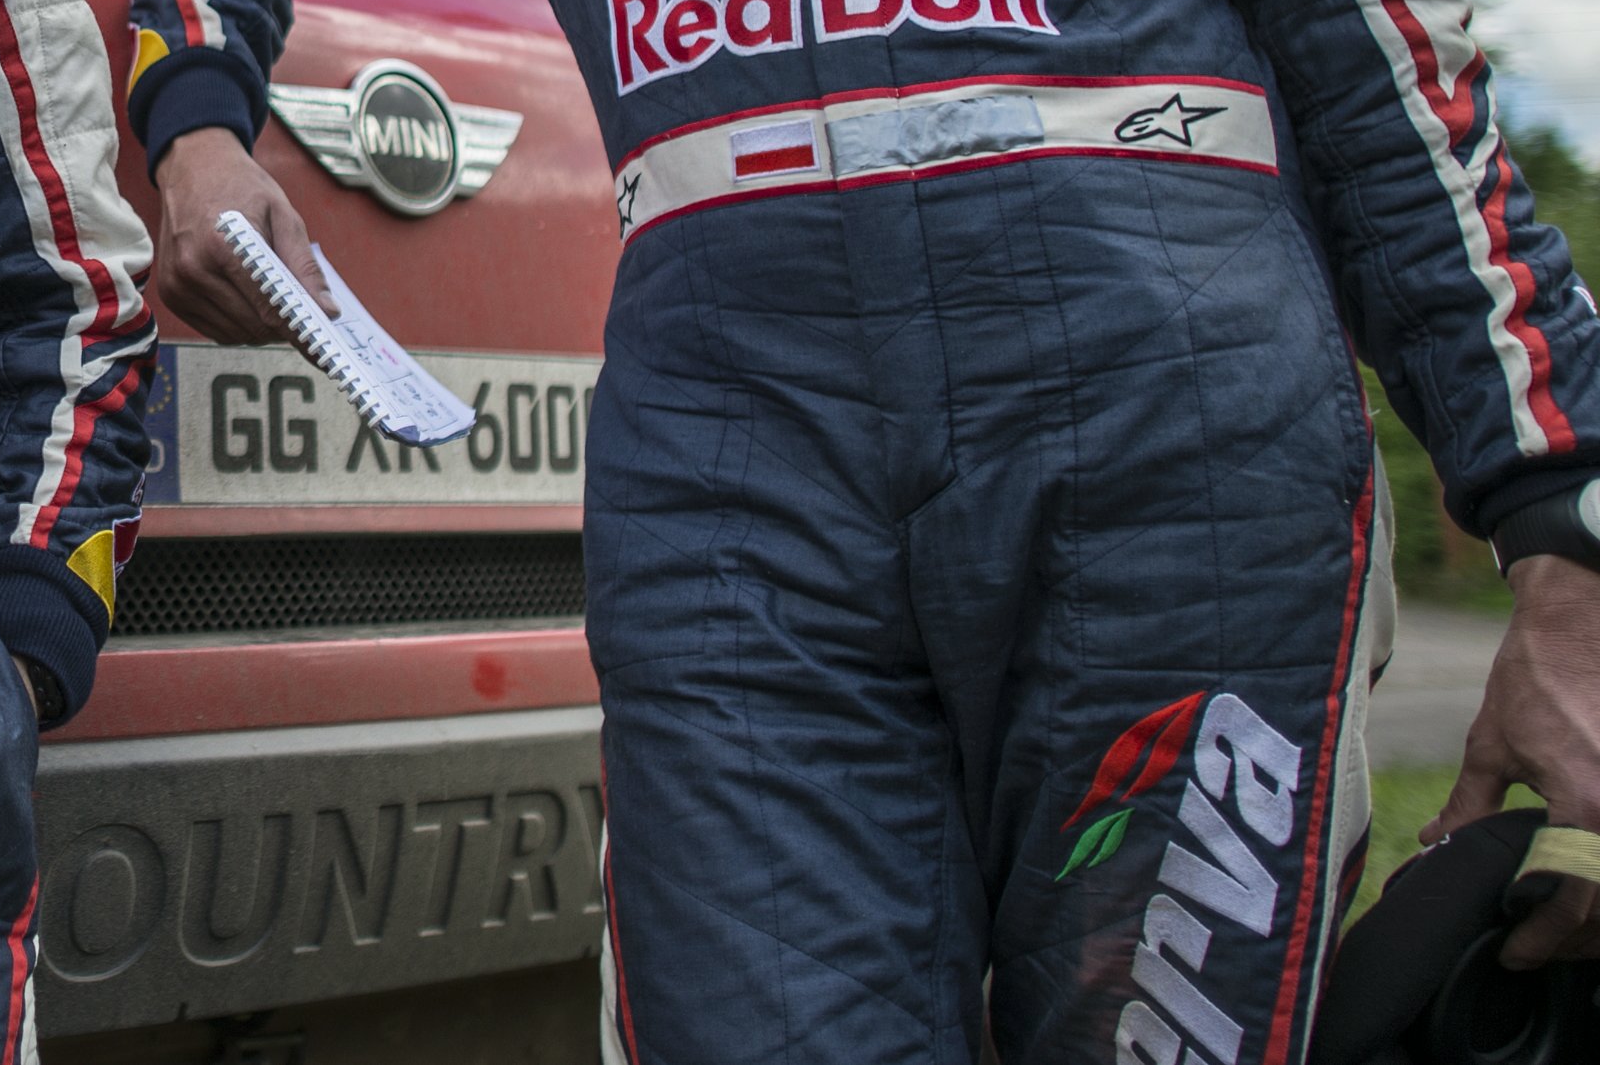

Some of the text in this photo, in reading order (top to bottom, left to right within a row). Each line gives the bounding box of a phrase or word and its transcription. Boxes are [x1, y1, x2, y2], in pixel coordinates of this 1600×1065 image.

[363, 113, 451, 162] MINI
[210, 373, 318, 474] GG
[467, 382, 594, 475] 600
